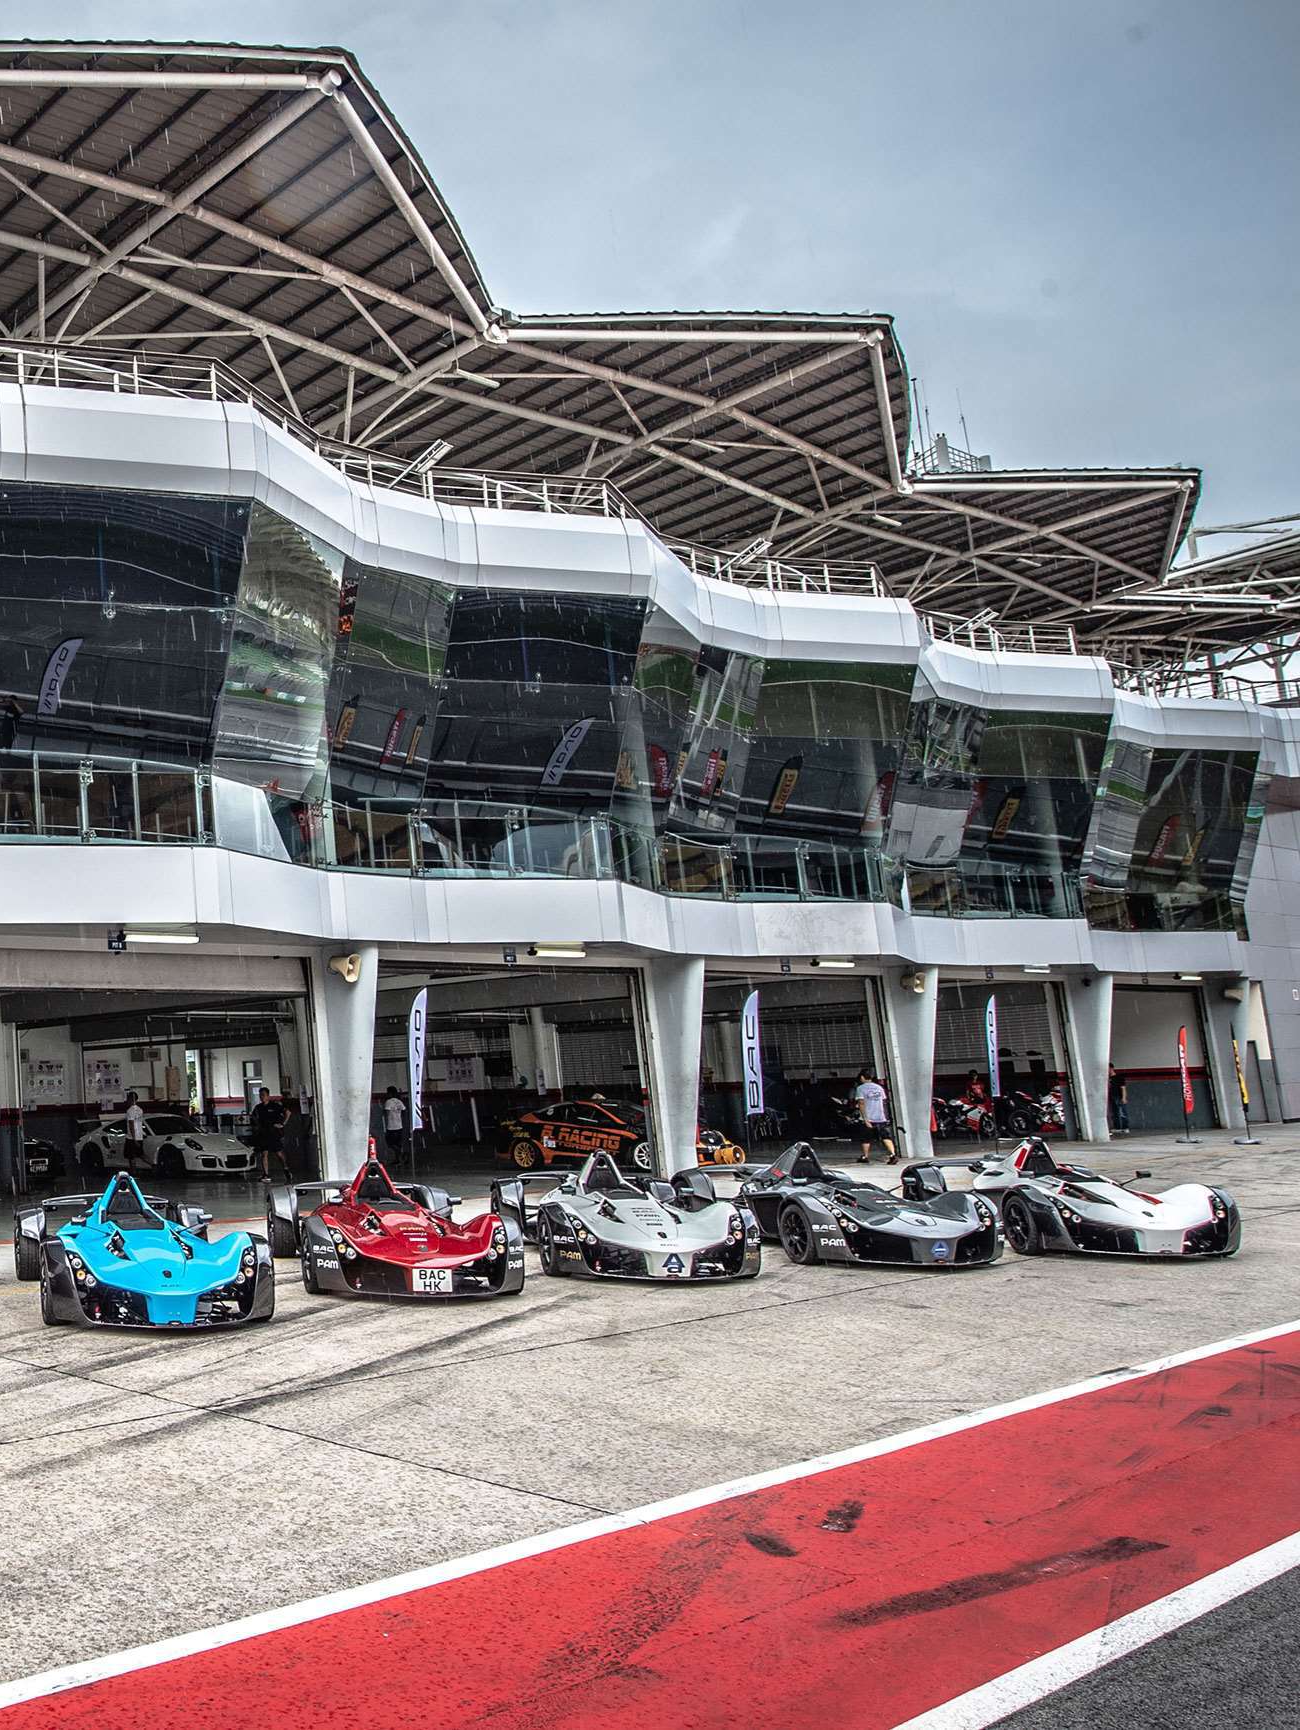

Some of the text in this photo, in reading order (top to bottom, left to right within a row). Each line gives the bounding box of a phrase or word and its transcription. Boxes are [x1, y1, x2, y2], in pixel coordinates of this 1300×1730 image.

[745, 1014, 760, 1109] BAC
[821, 1237, 846, 1247] PAM
[312, 1245, 334, 1253] BAC
[560, 1250, 582, 1260] PAM
[316, 1258, 339, 1269] PAM
[419, 1269, 446, 1280] BAC
[423, 1281, 442, 1291] HK
